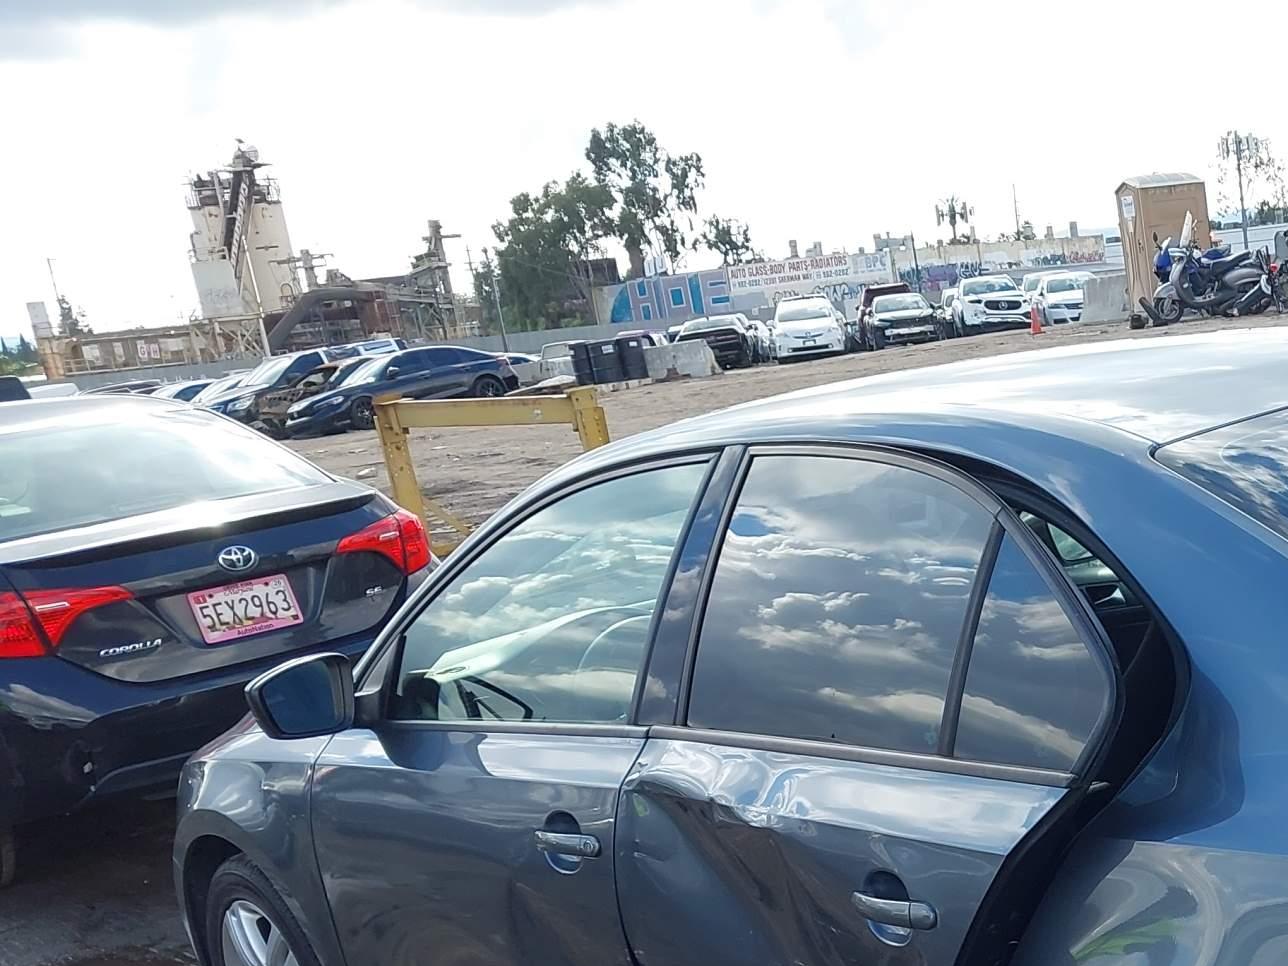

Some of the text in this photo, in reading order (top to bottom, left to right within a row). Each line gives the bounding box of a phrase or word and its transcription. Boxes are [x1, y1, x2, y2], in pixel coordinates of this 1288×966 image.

[730, 267, 747, 280] AUTO
[199, 589, 293, 630] 5EX2963
[237, 623, 274, 636] AutoNation
[99, 637, 163, 658] COROLLA
